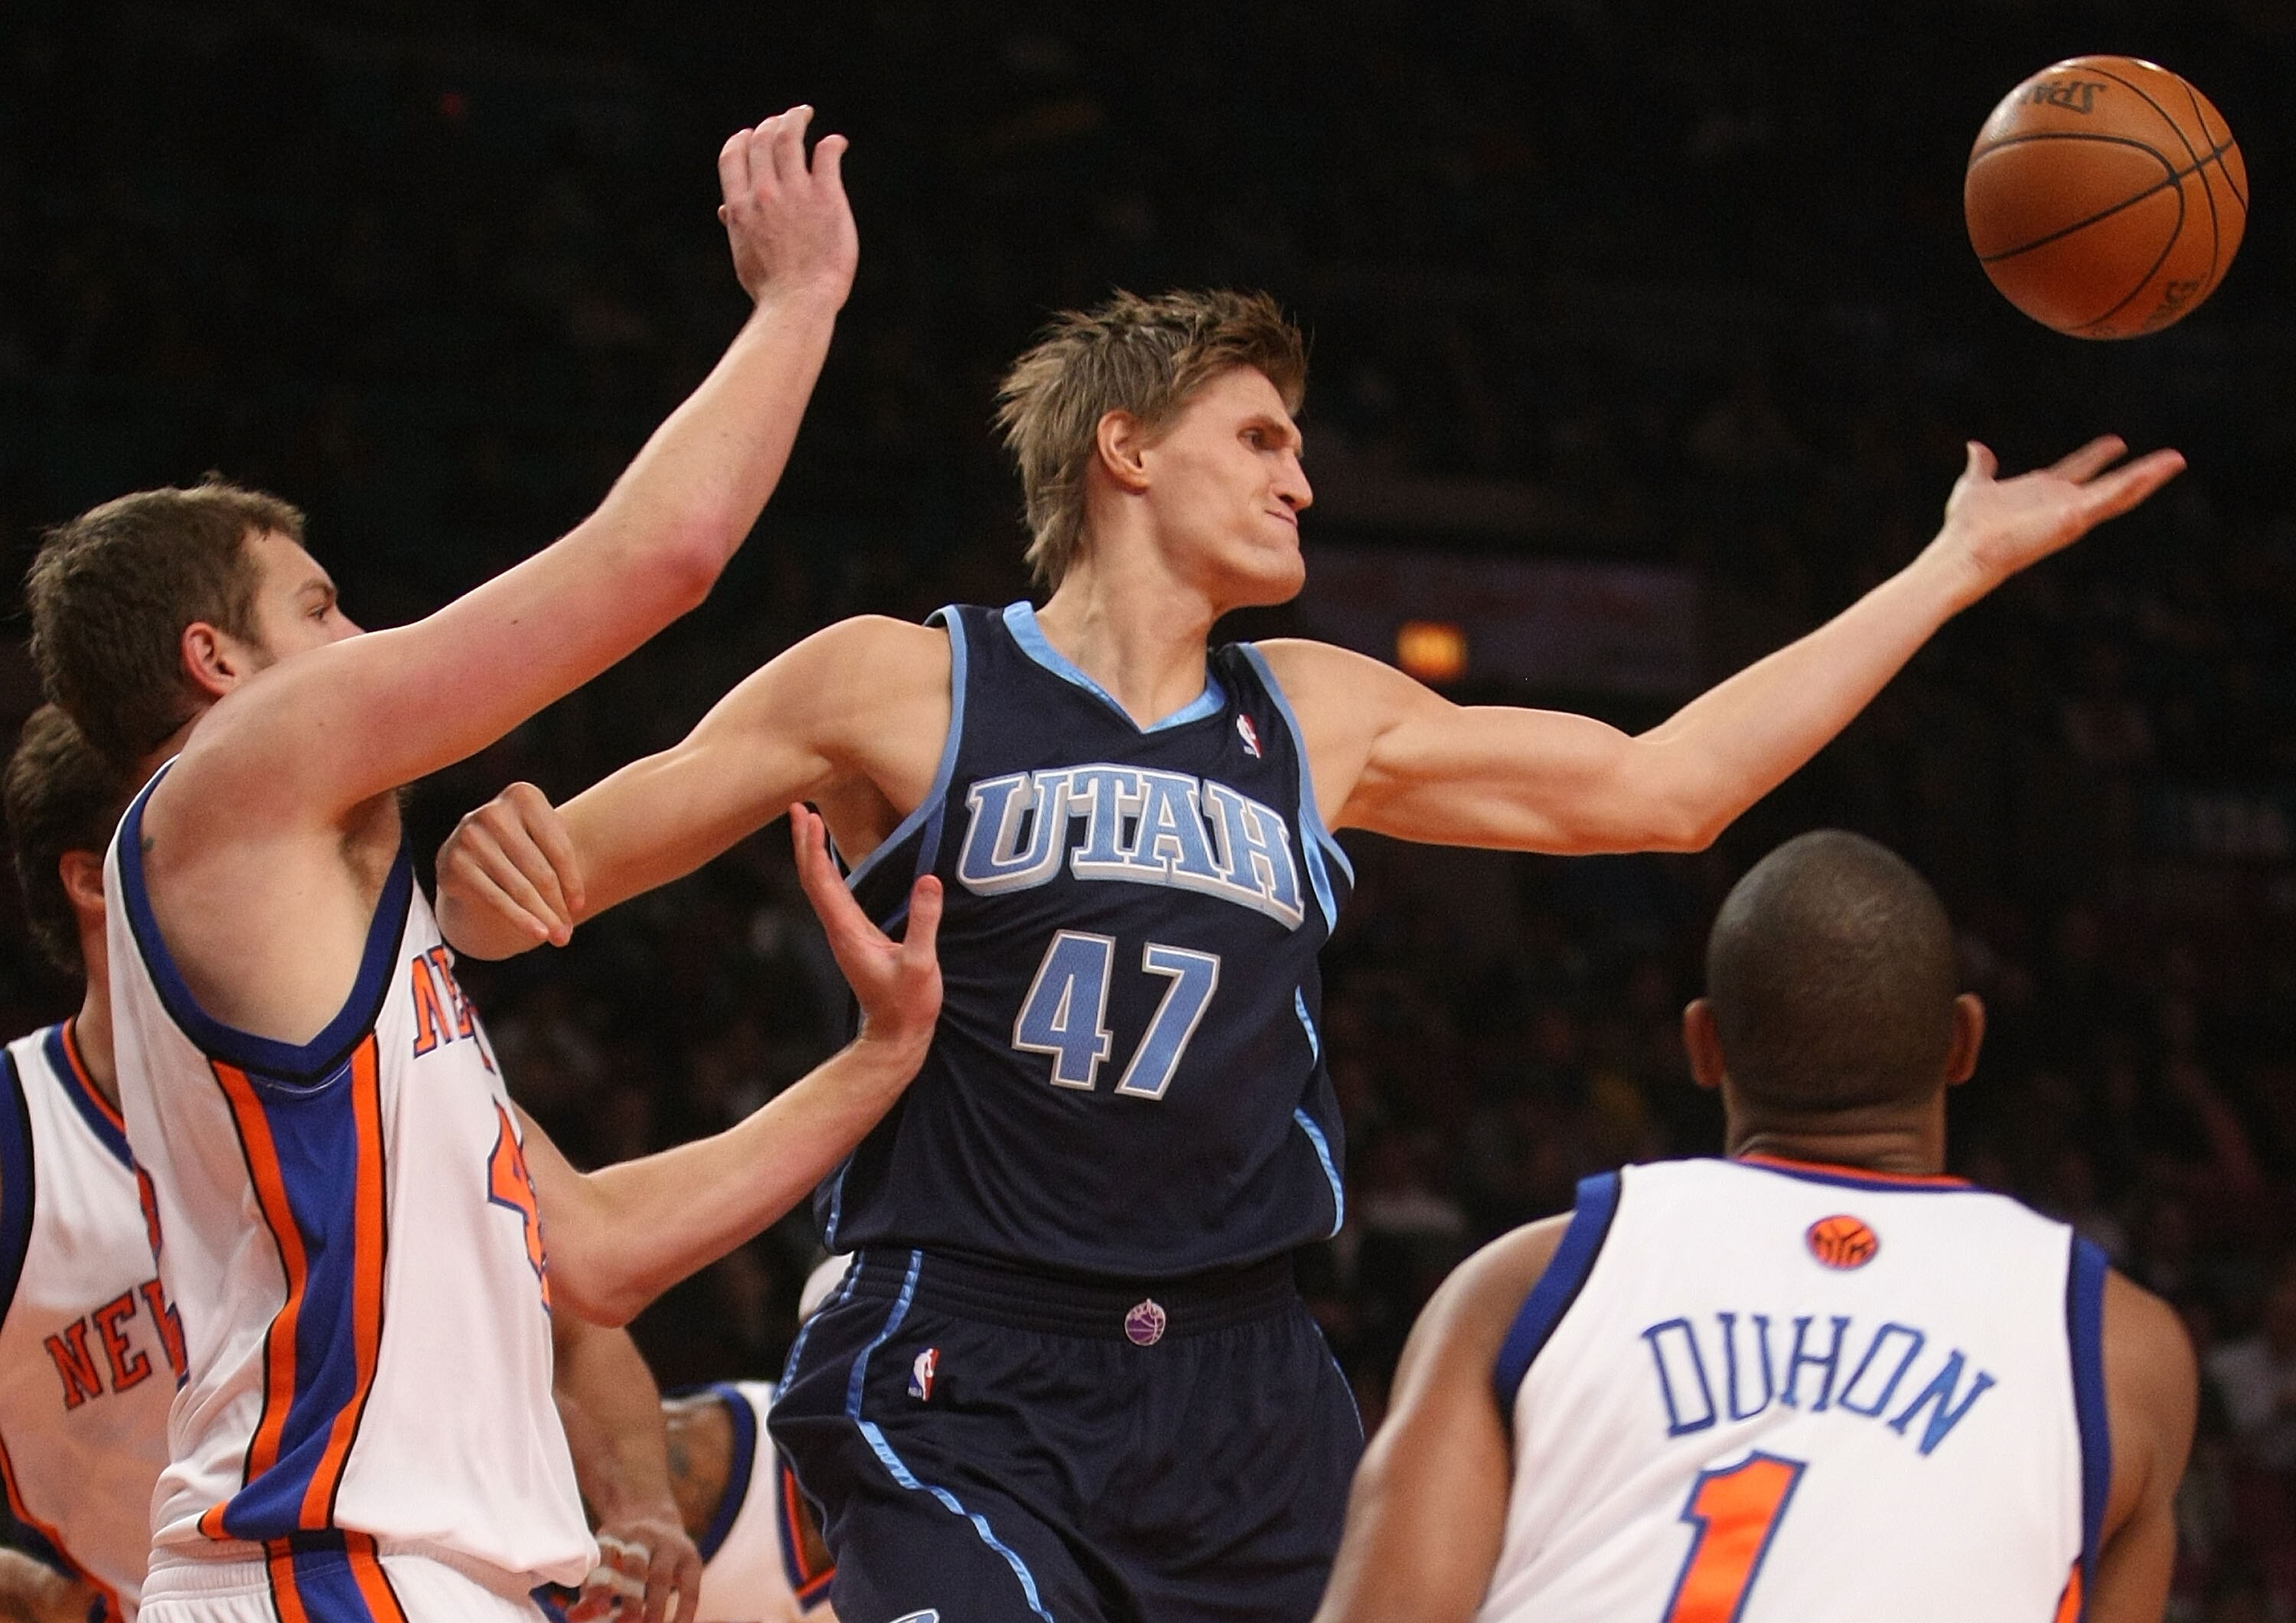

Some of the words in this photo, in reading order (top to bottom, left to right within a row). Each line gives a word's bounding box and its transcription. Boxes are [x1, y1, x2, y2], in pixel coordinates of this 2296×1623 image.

[956, 762, 1305, 932] UTAH
[1011, 928, 1221, 1101] 47
[1640, 1311, 1998, 1458] DUHON
[1661, 1449, 1809, 1623] 1
